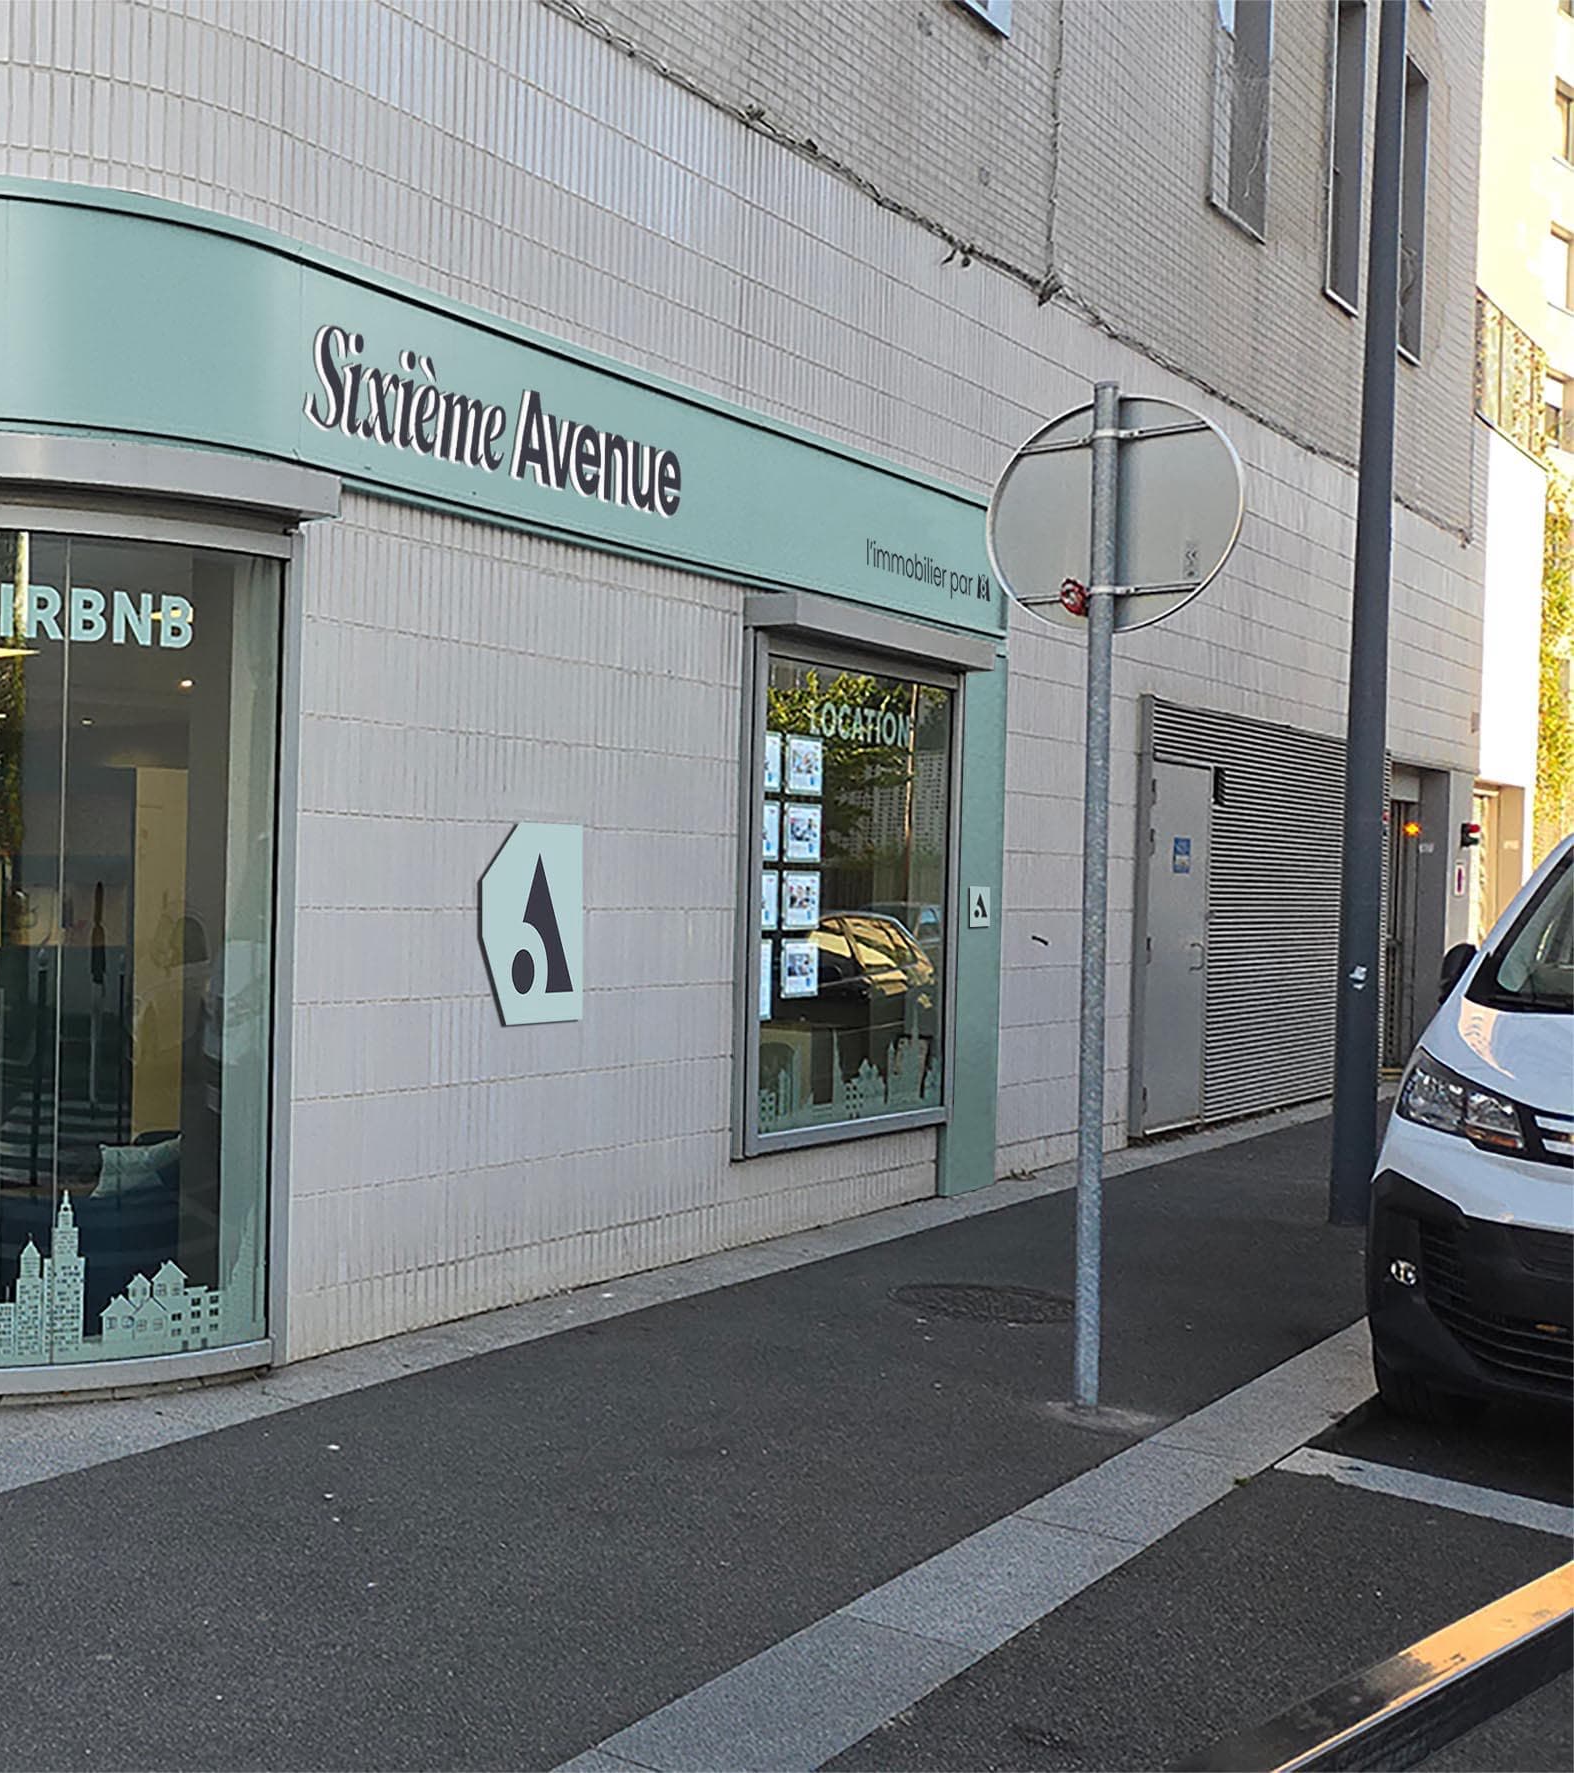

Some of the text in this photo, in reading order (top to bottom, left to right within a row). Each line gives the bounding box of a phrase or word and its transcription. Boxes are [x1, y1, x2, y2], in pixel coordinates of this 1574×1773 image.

[303, 325, 682, 519] Sixième Avenue
[866, 537, 947, 589] l'immobilier
[949, 570, 973, 600] par
[810, 701, 911, 748] LOCATION
